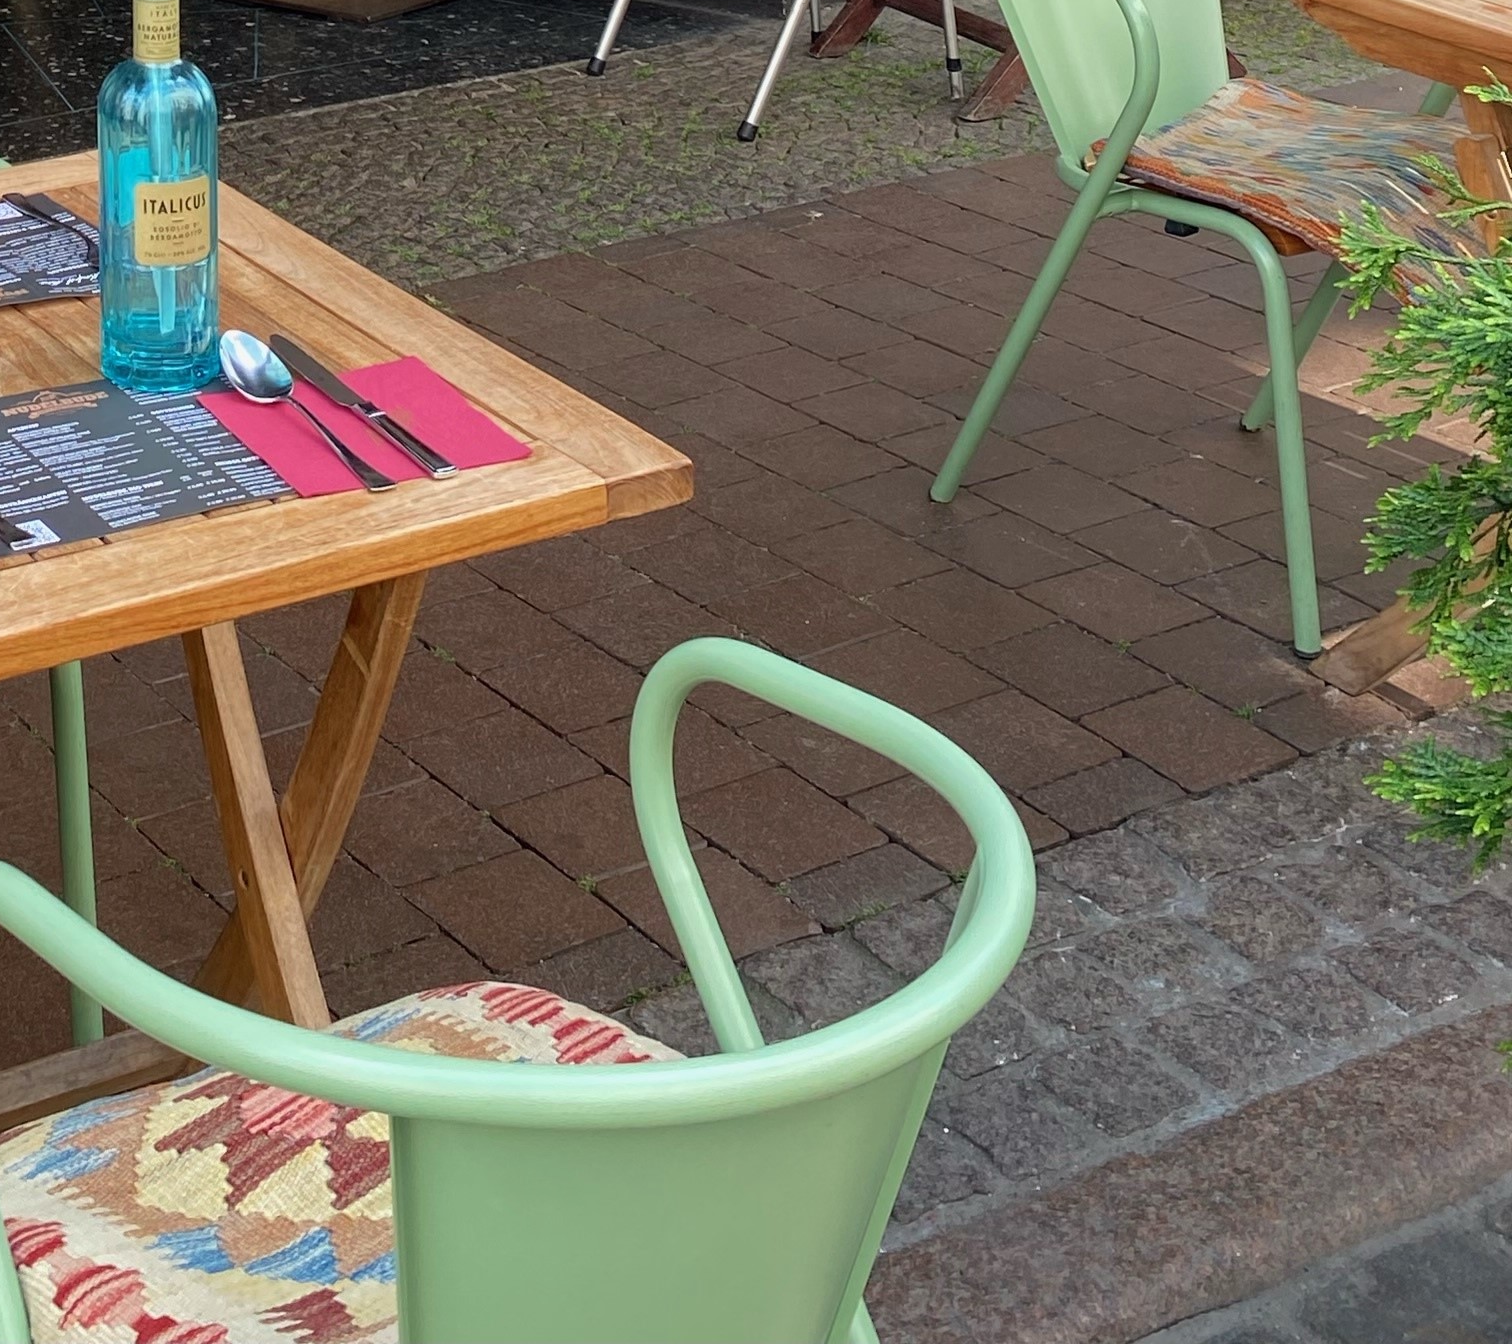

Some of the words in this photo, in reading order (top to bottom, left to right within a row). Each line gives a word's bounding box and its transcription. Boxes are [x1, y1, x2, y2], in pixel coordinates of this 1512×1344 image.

[138, 23, 178, 32] BERGAMO
[144, 33, 178, 41] NATURA
[143, 192, 206, 214] ITALICUS
[150, 229, 202, 241] BERGAMOTTO
